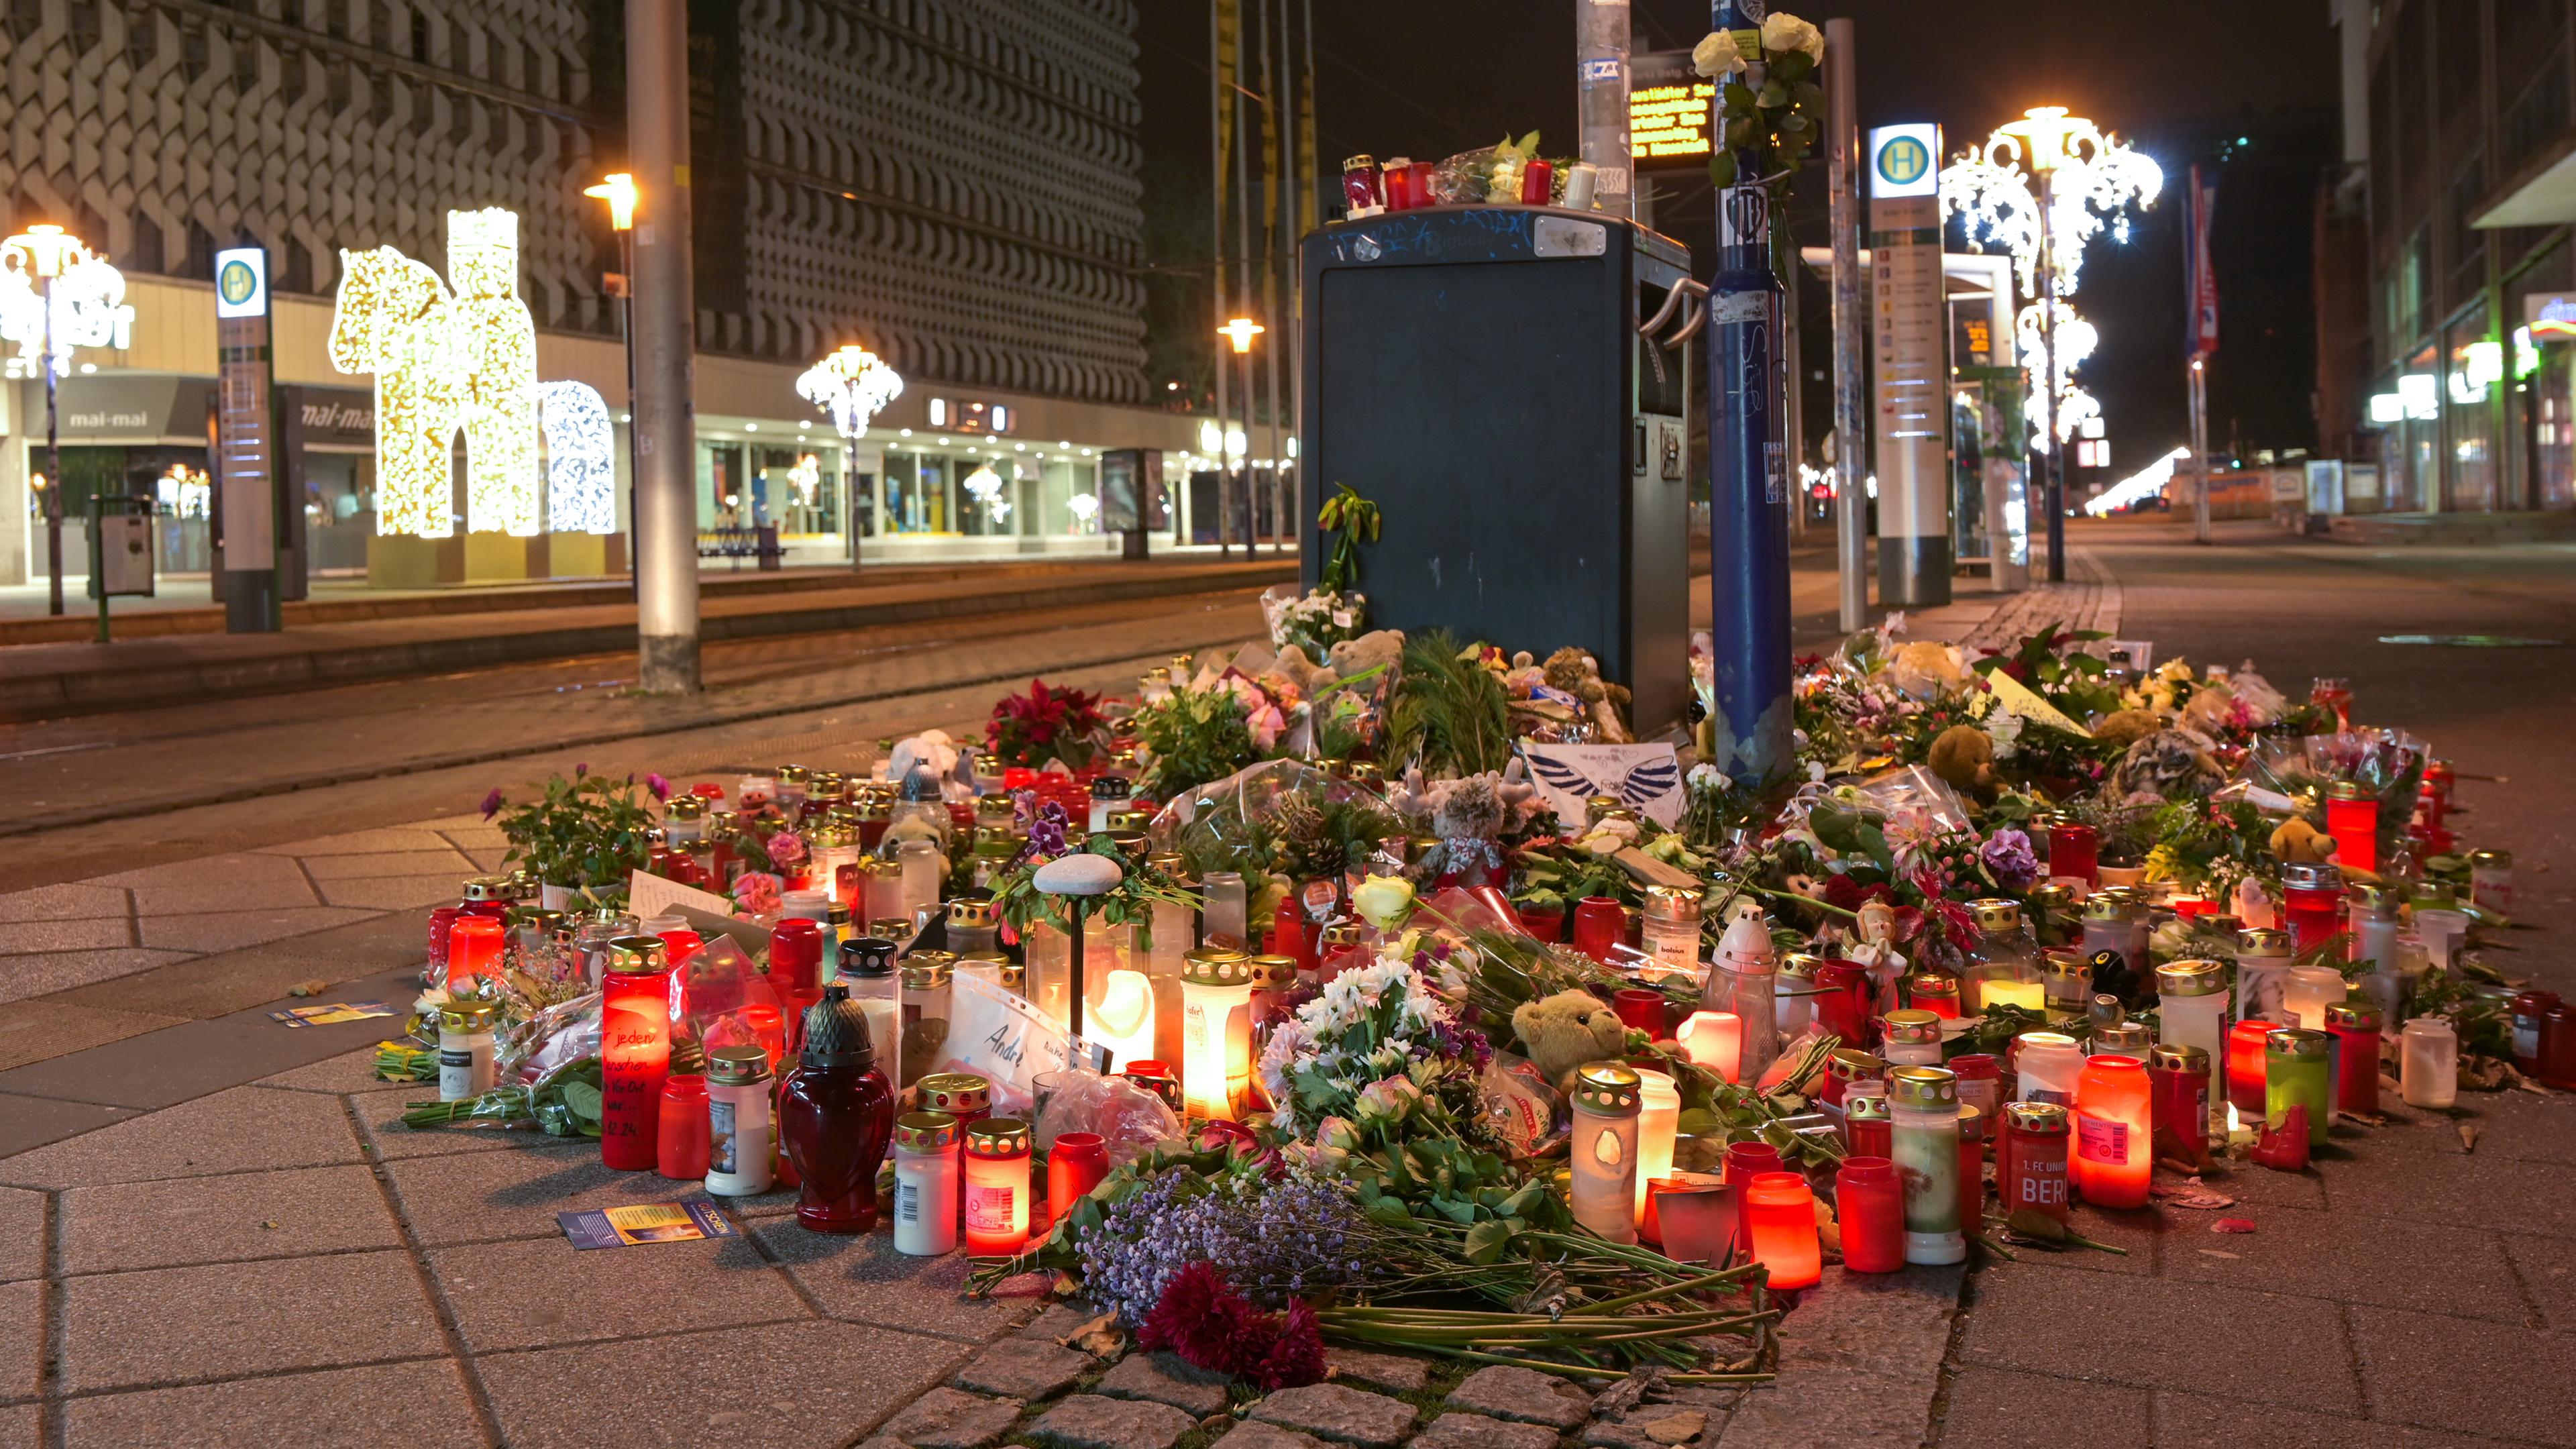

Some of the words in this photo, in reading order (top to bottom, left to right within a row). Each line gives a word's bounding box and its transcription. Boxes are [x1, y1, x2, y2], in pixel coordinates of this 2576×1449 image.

[70, 411, 147, 427] mai-mai
[1661, 946, 1684, 954] bolsius
[613, 1028, 656, 1051] jeden
[2023, 1159, 2031, 1171] 1.
[2033, 1161, 2045, 1172] FC
[697, 1202, 731, 1234] GUTSCHEIN
